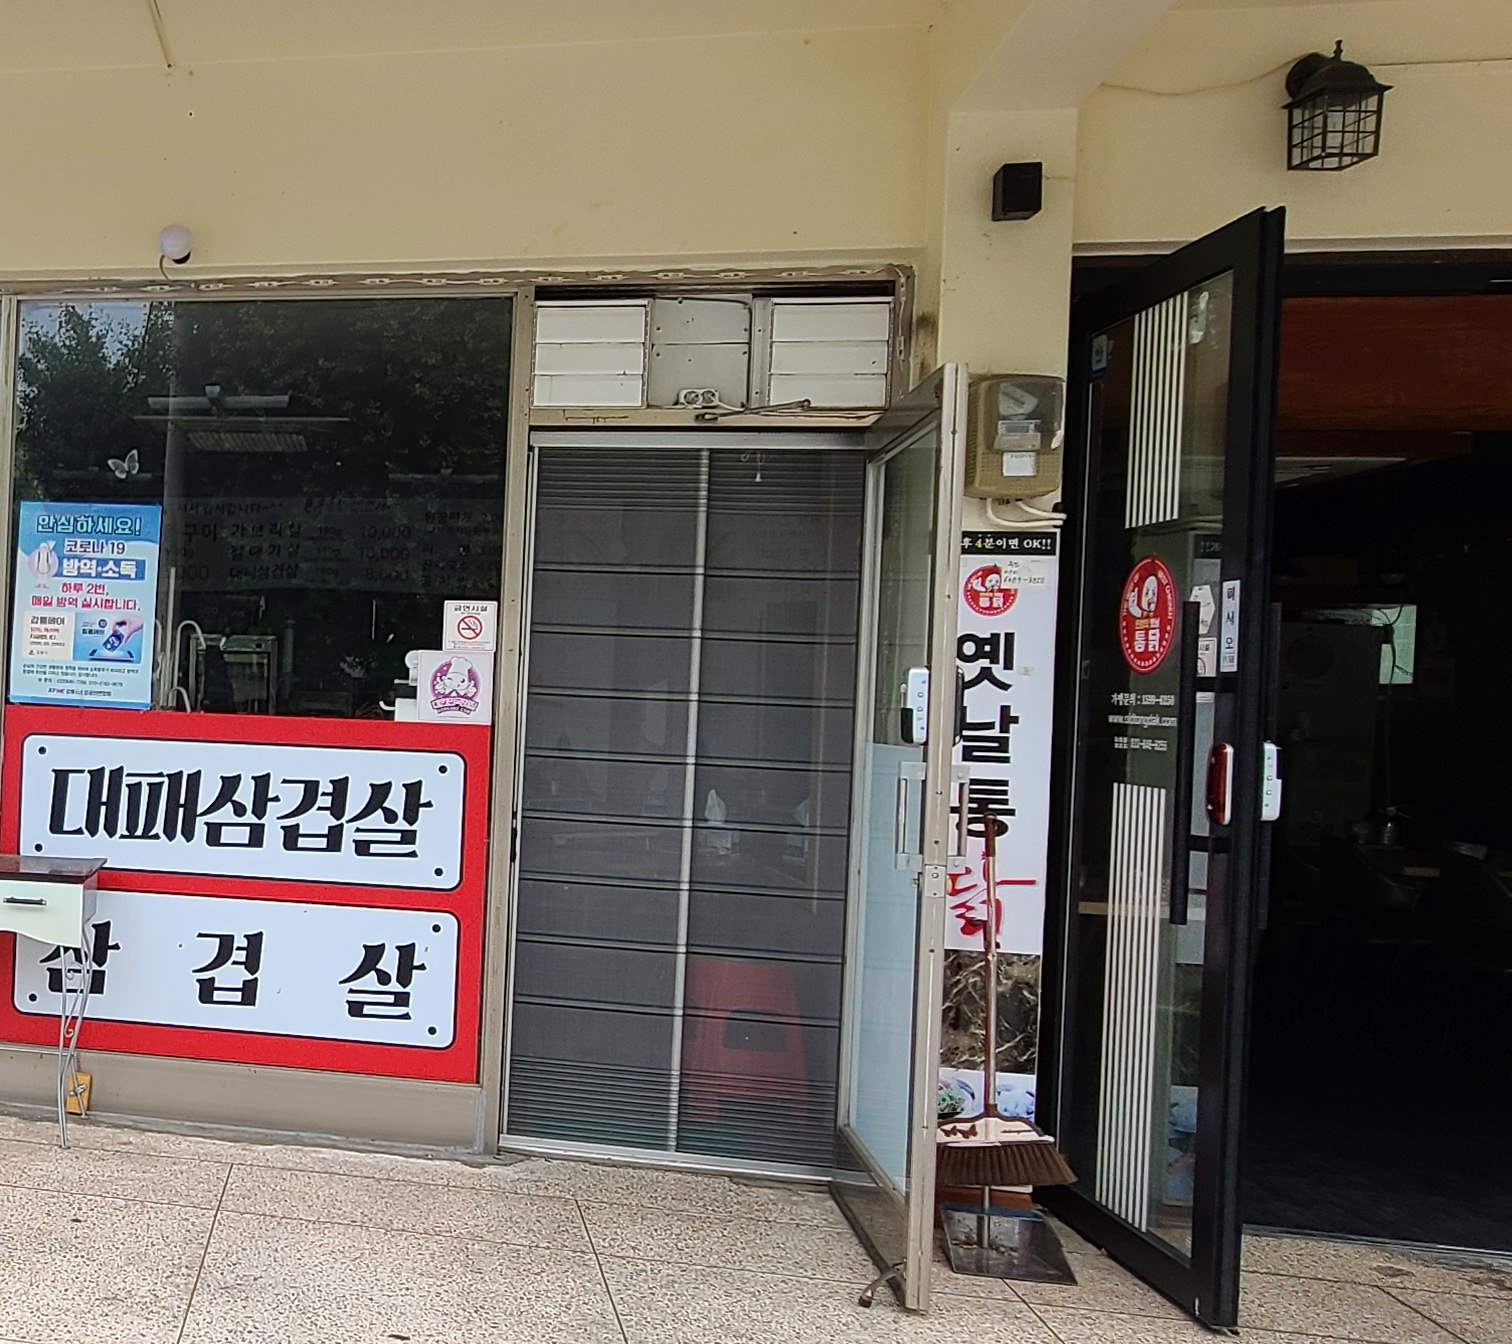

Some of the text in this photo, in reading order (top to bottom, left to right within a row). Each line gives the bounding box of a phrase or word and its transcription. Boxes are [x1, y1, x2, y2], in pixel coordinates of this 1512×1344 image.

[37, 513, 143, 536] 안심하세요!
[64, 538, 126, 555] 코로나 19
[1023, 538, 1052, 550] OK!!
[61, 582, 84, 595] 하루
[56, 596, 79, 609] 방역
[81, 597, 142, 612] 실시합니다.
[49, 764, 434, 859] 대패삼겹살
[39, 919, 428, 1021] 삼겹살
